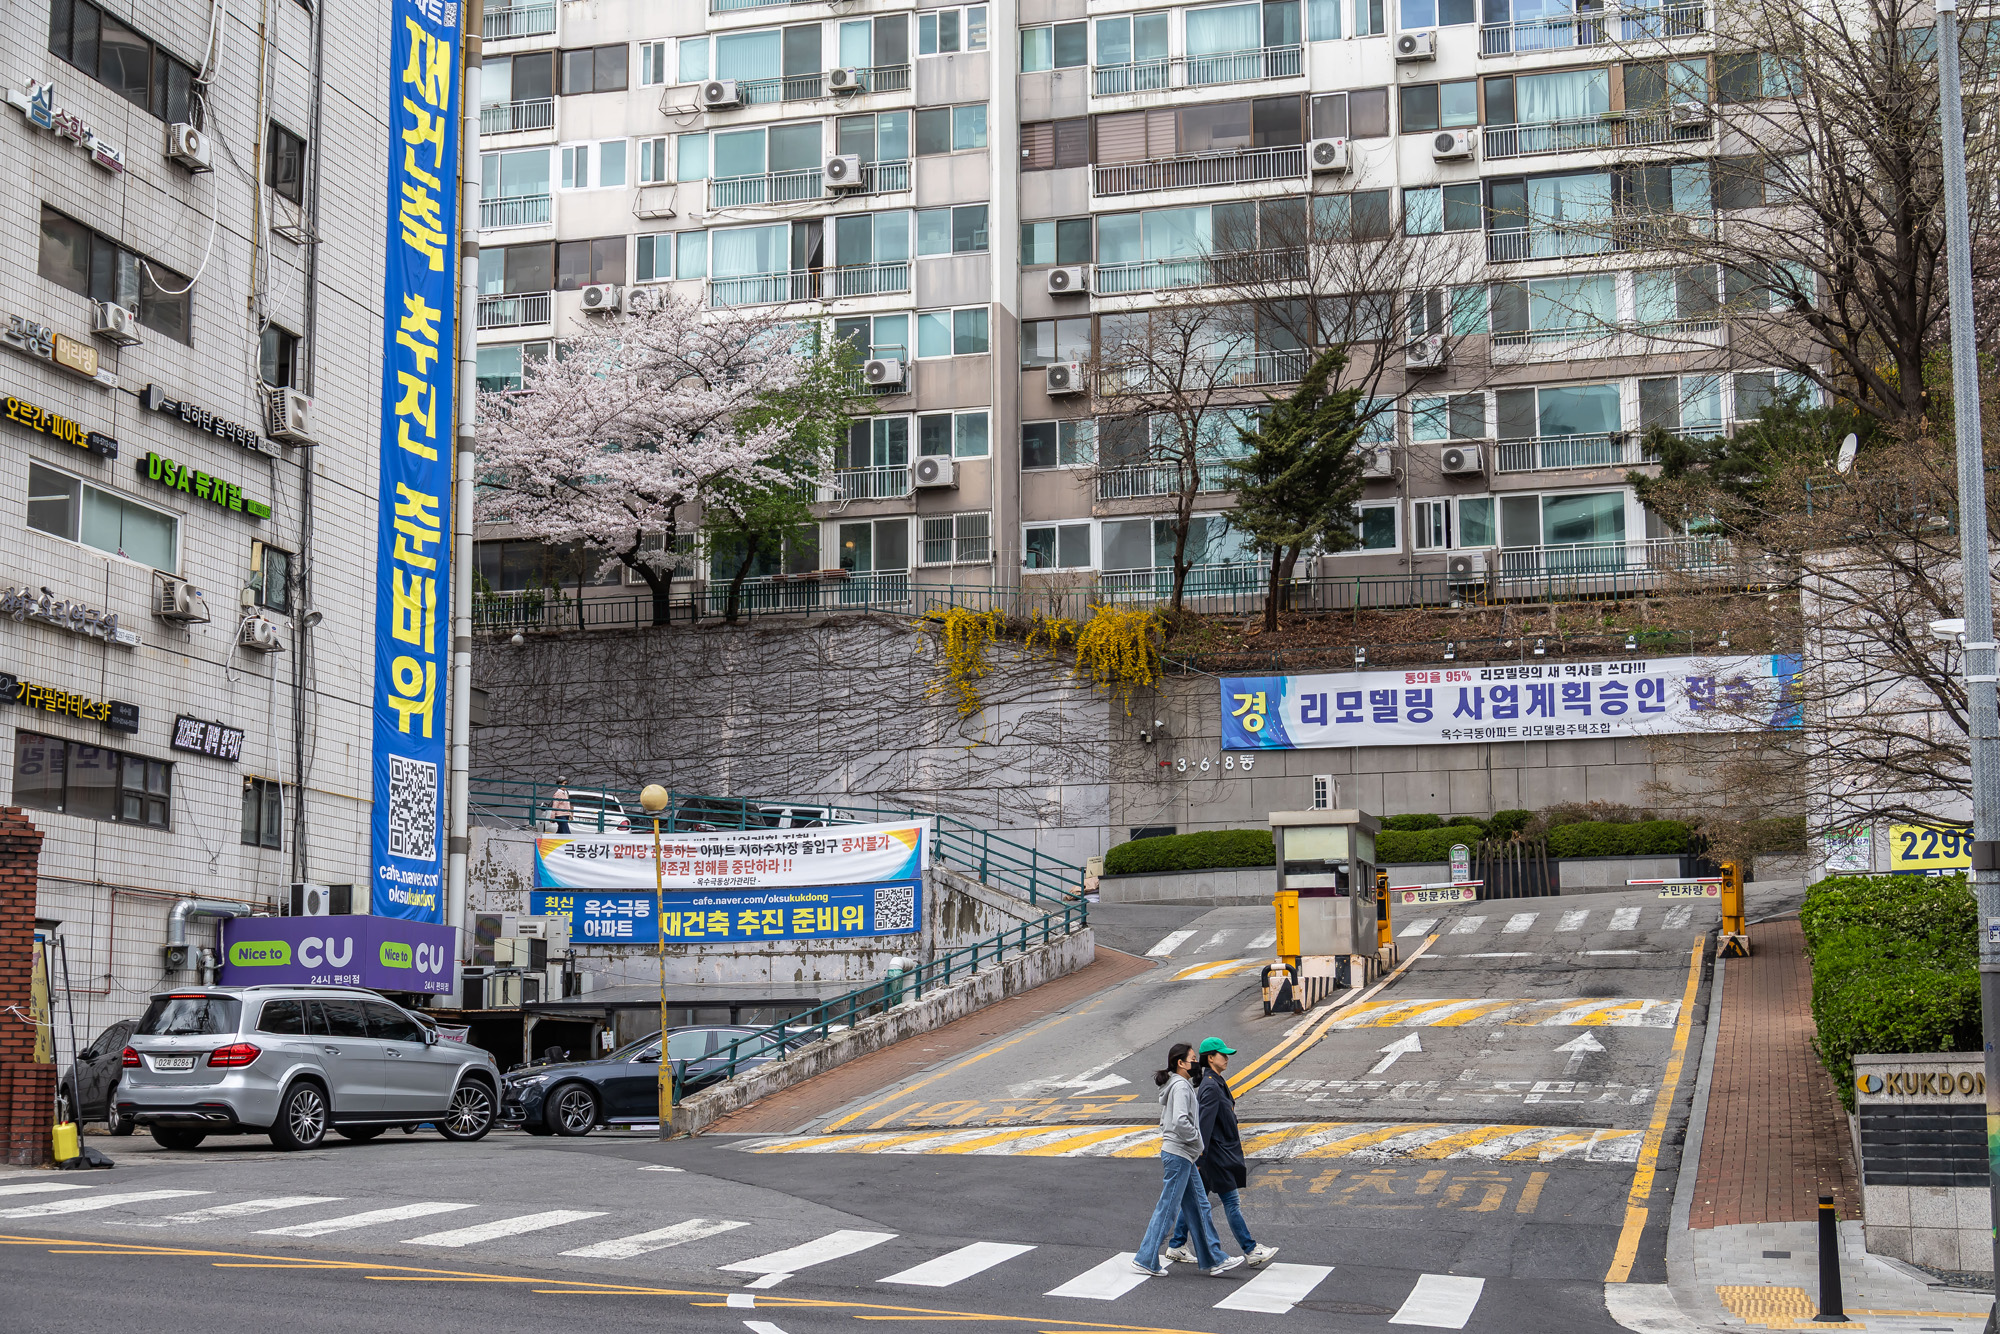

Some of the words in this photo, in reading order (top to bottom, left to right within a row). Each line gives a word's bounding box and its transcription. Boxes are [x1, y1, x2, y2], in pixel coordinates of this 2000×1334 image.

[399, 15, 450, 271] 재건축
[59, 338, 94, 372] 머리방
[395, 291, 441, 462] 추진
[180, 401, 214, 432] 맨하탄
[215, 416, 257, 451] 음악학원
[148, 451, 190, 494] DSA
[195, 469, 242, 513] 뮤지컬
[388, 482, 441, 739] 준비위
[1405, 671, 1441, 685] 동의율
[1445, 670, 1472, 682] 95%
[1480, 666, 1543, 681] 리모델링의
[1547, 665, 1560, 678] 새
[1564, 663, 1603, 678] 역사를
[1608, 661, 1647, 676] 쓰다!!!
[96, 702, 112, 722] 3F
[1231, 691, 1267, 733] 경
[1300, 687, 1434, 726] 리모델링
[1452, 677, 1667, 720] 사업계획승인
[1441, 726, 1518, 740] 옥수극동아파트
[1522, 722, 1611, 737] 리모델링주택조합
[564, 843, 610, 859] 극동상가
[613, 843, 648, 859] 앞마당
[700, 843, 736, 858] 아파트
[739, 841, 799, 857] 지하수차장
[801, 839, 839, 855] 출입구
[841, 834, 891, 853] 공사불가
[694, 860, 729, 876] 침해를
[732, 858, 780, 875] 중단하라
[692, 892, 829, 906] cafe.naver.com/oksukukdong
[1417, 889, 1460, 903] 방문차량
[1660, 885, 1704, 897] 주민차량
[584, 899, 651, 918] 옥수극동
[583, 919, 633, 938] 아파트
[663, 909, 730, 938] 재건축
[736, 908, 784, 936] 추진
[791, 905, 864, 935] 준비위
[238, 947, 267, 960] Nice
[269, 947, 283, 960] to
[297, 936, 353, 968] CU
[384, 947, 400, 961] Nice
[400, 952, 408, 963] to
[415, 942, 444, 975] CU
[311, 975, 331, 985] 24시
[334, 974, 360, 985] 편의점
[424, 980, 435, 990] 24시
[436, 981, 450, 992] 편의점
